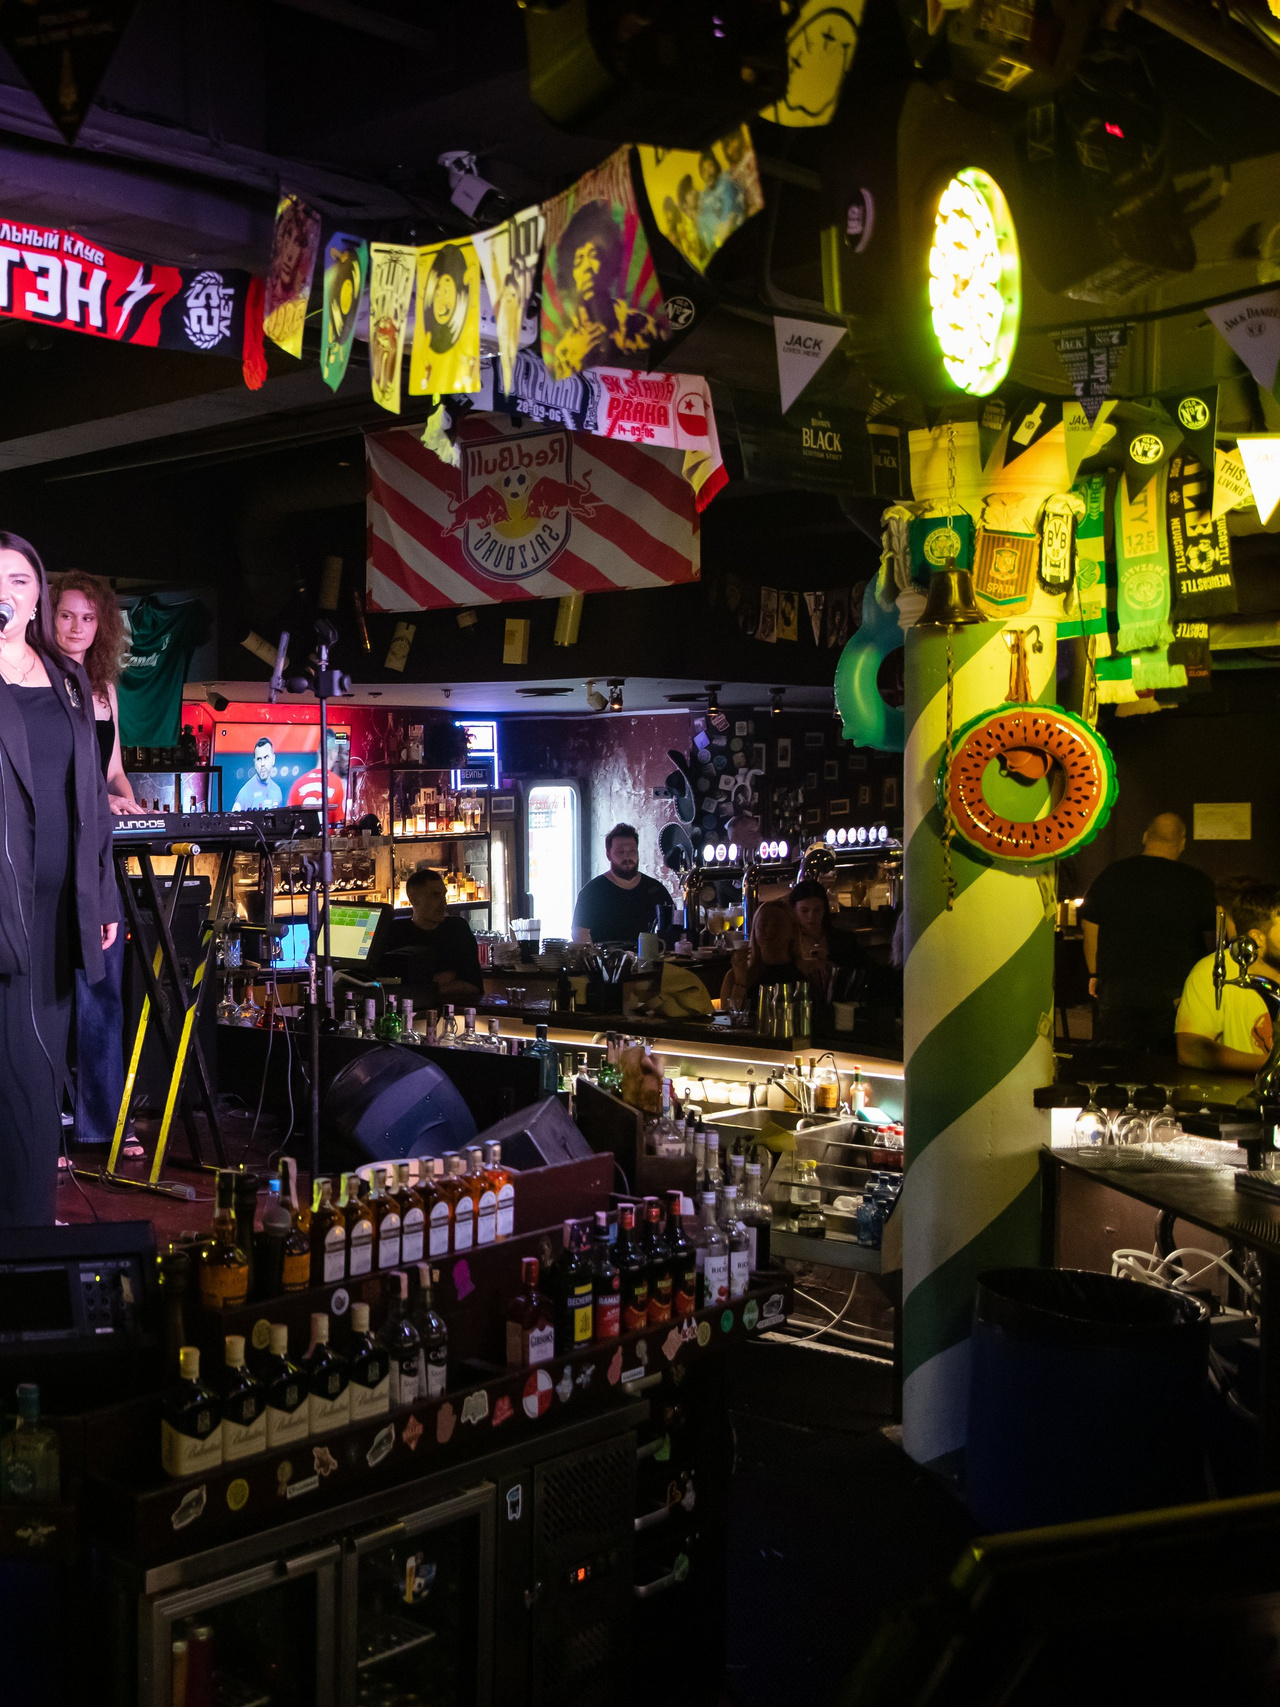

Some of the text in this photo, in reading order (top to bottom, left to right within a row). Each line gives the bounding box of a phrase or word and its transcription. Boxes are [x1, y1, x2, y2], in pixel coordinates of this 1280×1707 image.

[62, 233, 106, 267] КЛУБ
[186, 283, 220, 336] 25
[219, 285, 235, 338] ЛЕТ
[1223, 314, 1247, 333] JACK
[785, 334, 823, 351] JACK
[600, 374, 675, 401] SK SLAVIA
[516, 402, 563, 422] 28-09-06
[607, 397, 669, 426] PRAHA
[1068, 415, 1088, 426] JAC
[618, 424, 655, 439] 14-09-06
[801, 427, 843, 452] BLACK
[874, 456, 897, 468] BLACK
[1220, 460, 1245, 481] THIS
[1217, 475, 1245, 497] LIVING
[1047, 522, 1067, 549] BVB
[1125, 530, 1155, 548] 125
[1171, 517, 1187, 574] NEWCASTLE
[1218, 513, 1230, 566] EWCASTLE
[1127, 543, 1156, 555] YEARS
[1120, 563, 1168, 583] CITYZENS
[1181, 573, 1232, 594] NEWCASTLE
[986, 582, 1015, 595] SPAIN
